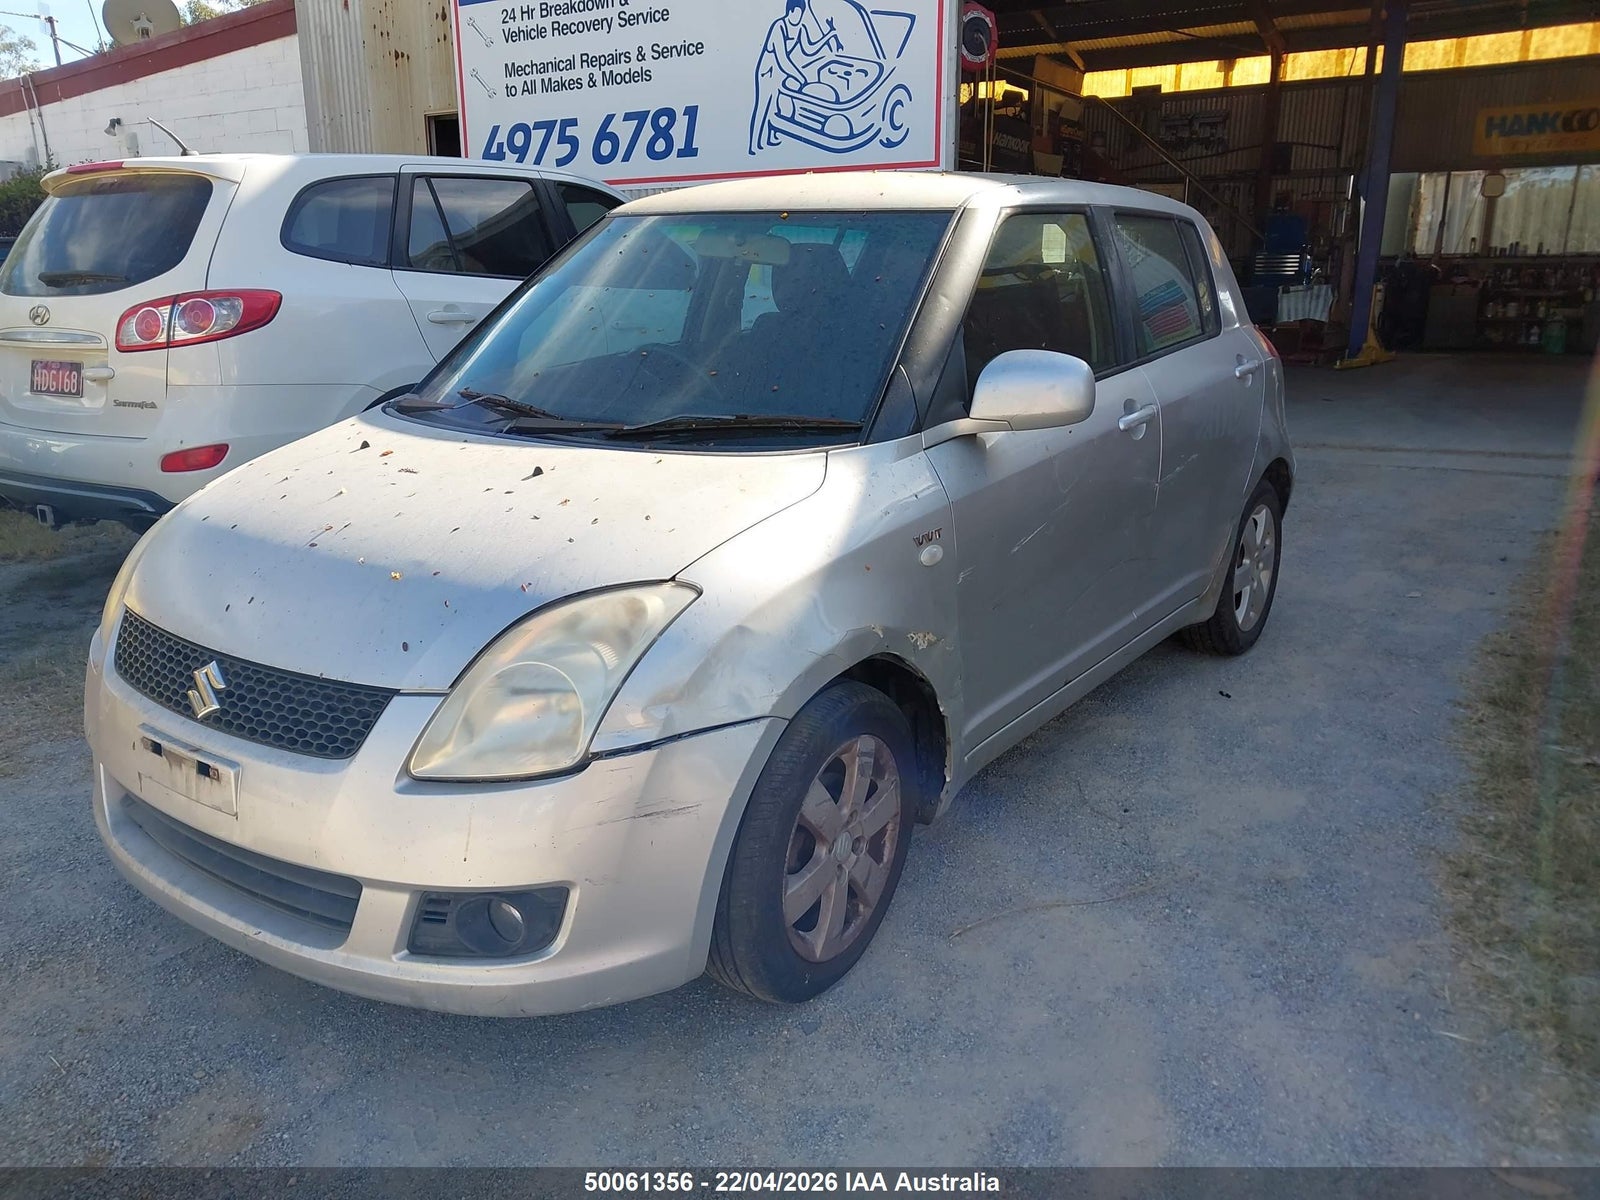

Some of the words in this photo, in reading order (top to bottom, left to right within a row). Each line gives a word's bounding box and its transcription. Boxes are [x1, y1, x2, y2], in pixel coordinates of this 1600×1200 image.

[501, 8, 516, 24] 24
[520, 5, 535, 21] Hr
[540, 0, 614, 18] Breakdown
[502, 24, 547, 43] Vehicle
[551, 16, 613, 34] Recovery
[618, 7, 670, 28] Service
[504, 54, 576, 78] Mechanical
[580, 49, 632, 71] Repairs
[636, 45, 646, 63] &
[650, 40, 705, 60] Service
[505, 83, 517, 98] to
[521, 79, 537, 96] All
[541, 76, 583, 94] Makes
[587, 72, 597, 89] &
[602, 66, 653, 86] Models
[481, 117, 580, 168] 4975
[591, 104, 699, 165] 6781
[33, 368, 78, 393] HDG168
[913, 528, 943, 547] VVT
